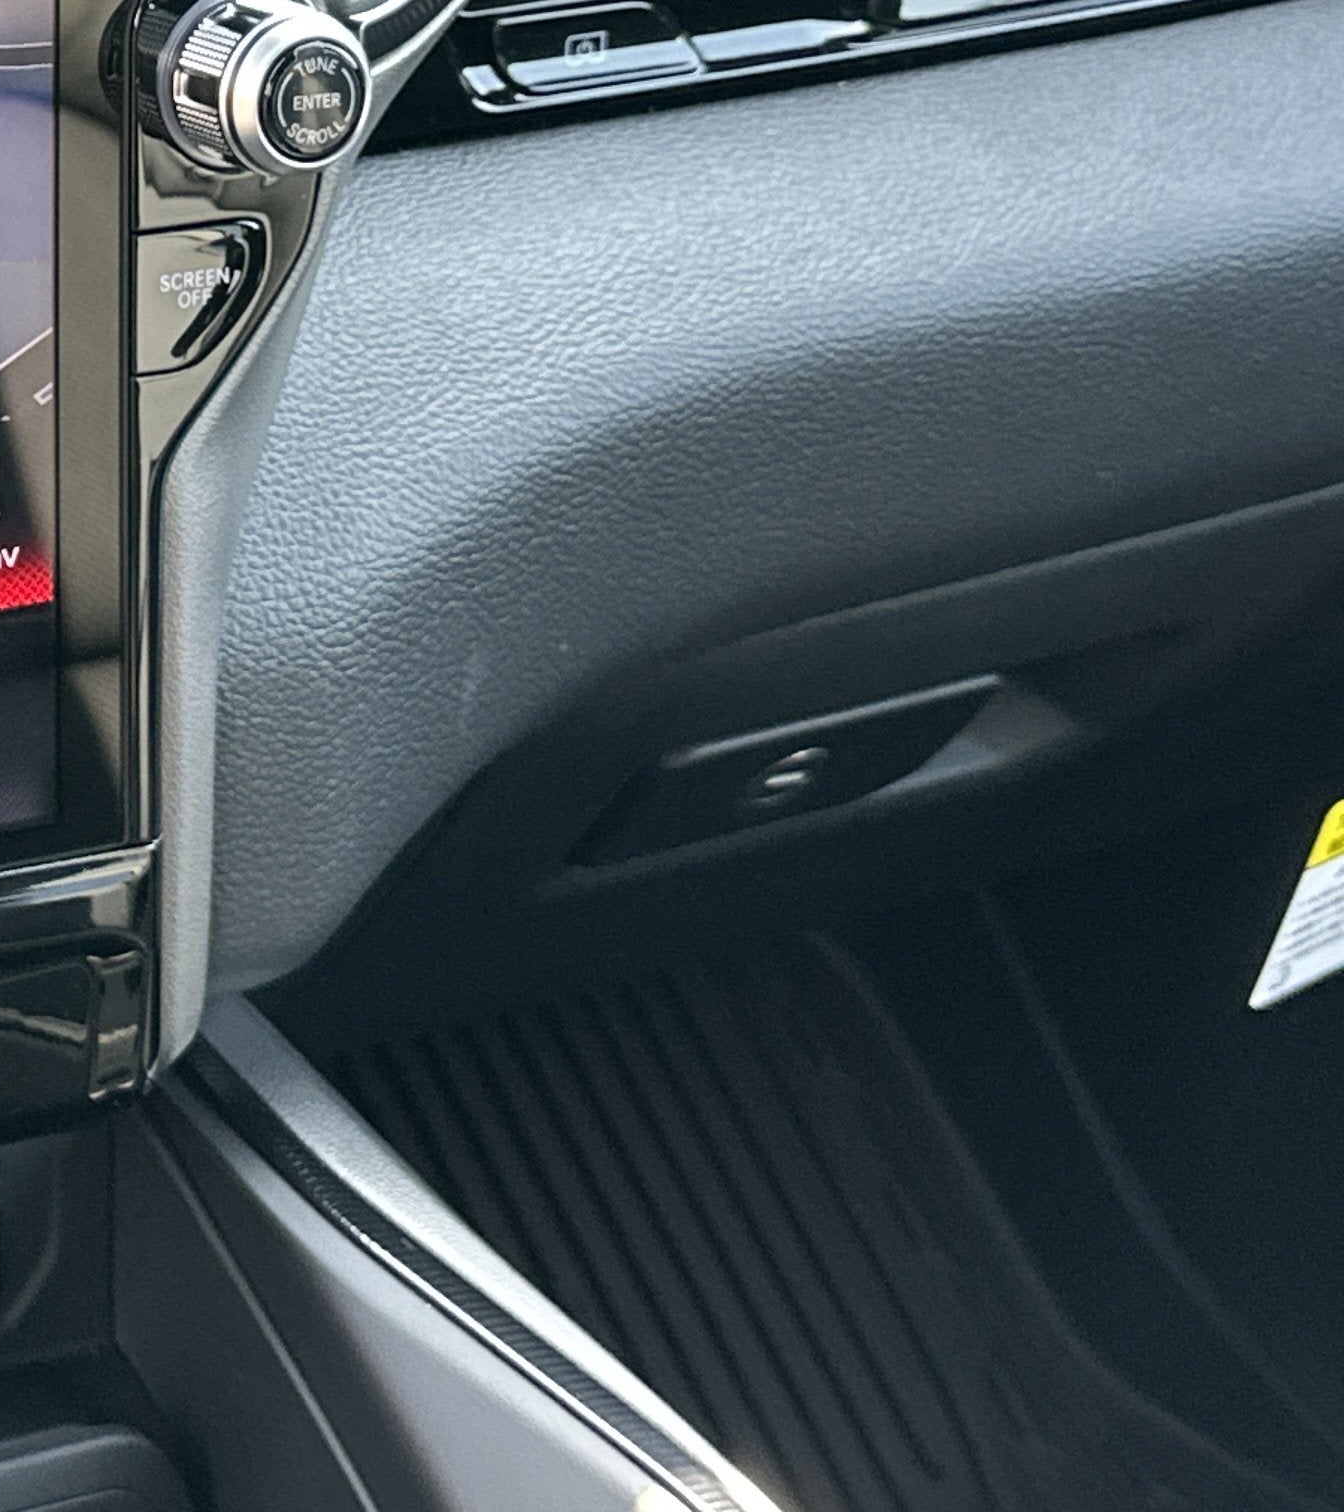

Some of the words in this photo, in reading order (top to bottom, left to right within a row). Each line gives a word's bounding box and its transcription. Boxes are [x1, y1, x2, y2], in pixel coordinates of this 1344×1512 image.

[293, 56, 340, 78] TUNE
[293, 92, 342, 111] ENTER
[286, 121, 346, 145] SCROLL
[159, 266, 230, 293] SCREEN
